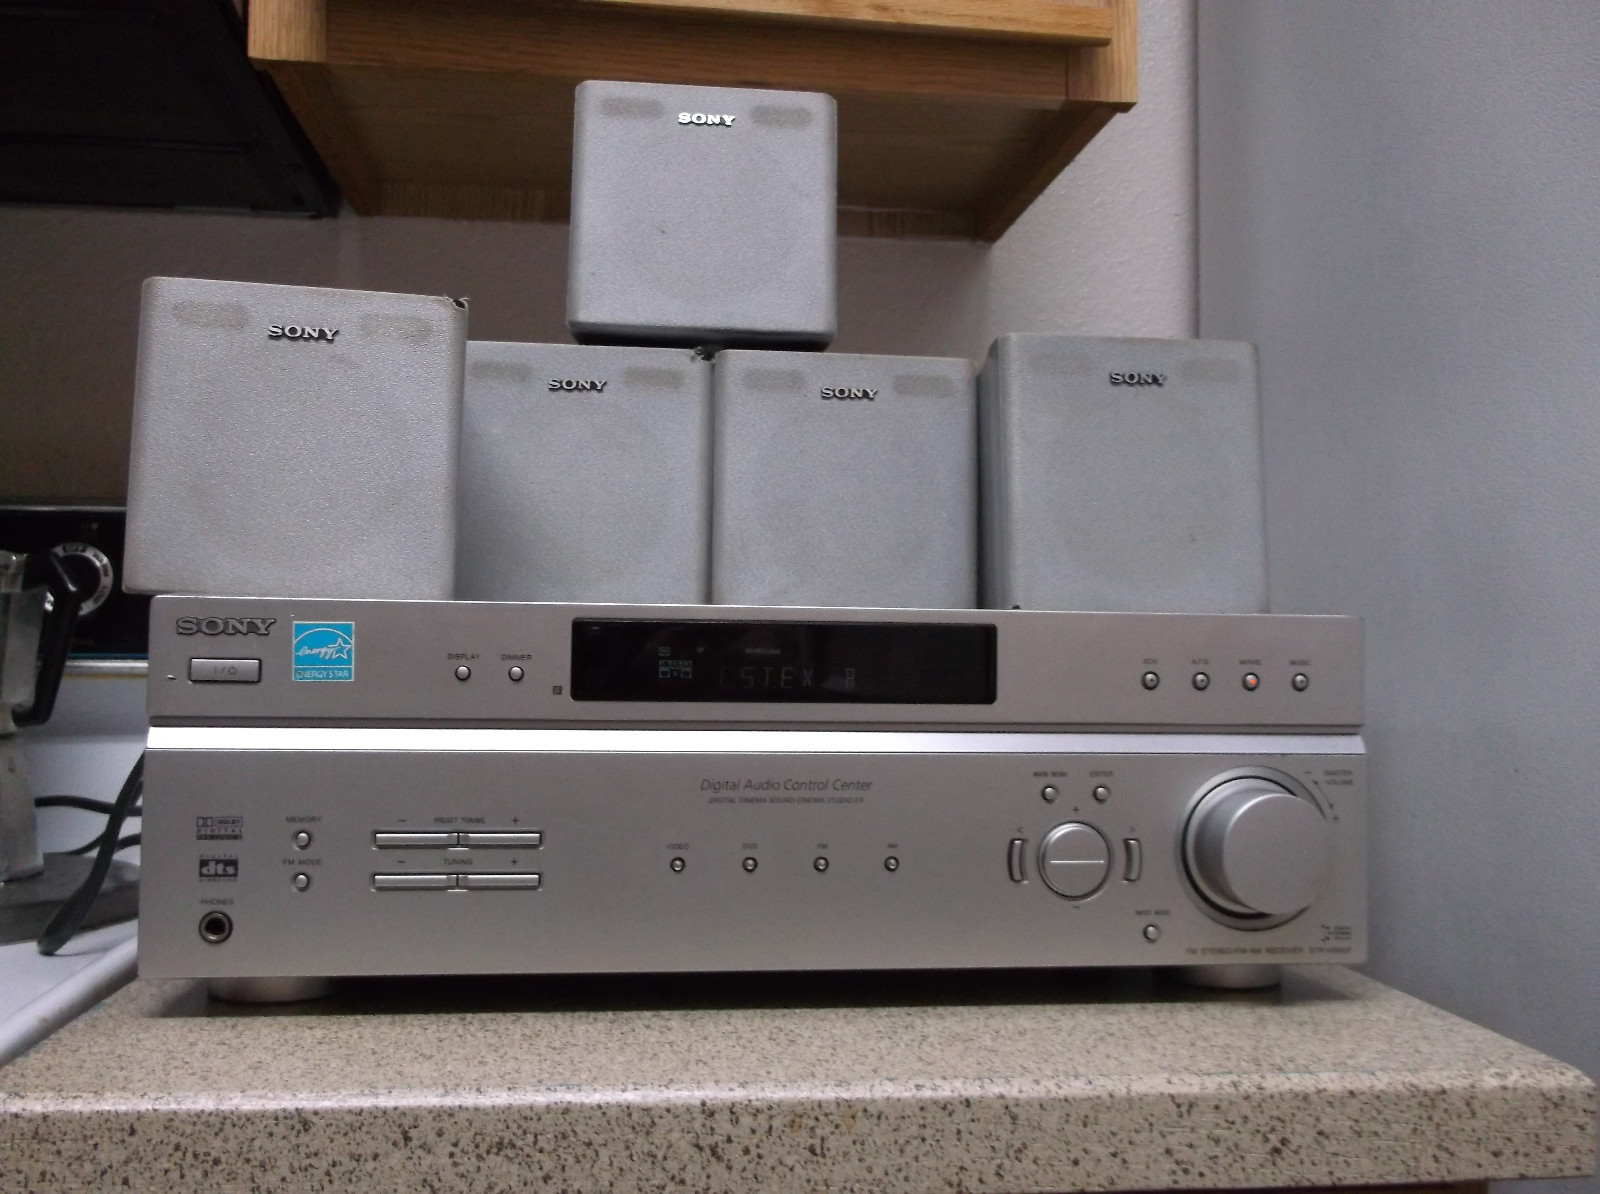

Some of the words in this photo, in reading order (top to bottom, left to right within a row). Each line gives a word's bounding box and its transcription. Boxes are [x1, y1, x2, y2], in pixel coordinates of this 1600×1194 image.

[678, 112, 736, 127] SONY
[267, 324, 339, 343] SONY
[1109, 371, 1166, 387] SONY
[548, 378, 607, 393] SONY
[821, 385, 877, 401] SONY
[175, 616, 277, 637] SONY
[447, 652, 481, 661] DISPLAY
[500, 653, 533, 662] DIMMER
[295, 669, 328, 679] ENERGY
[329, 669, 349, 679] STAR
[699, 778, 740, 794] Digital
[743, 778, 781, 792] Audio
[783, 778, 829, 792] Control
[832, 778, 873, 792] Center
[285, 815, 323, 824] MEMORY
[433, 816, 458, 825] PRESET
[461, 816, 486, 825] TUNING
[666, 842, 690, 850] VIDEO
[282, 858, 296, 866] FM
[297, 858, 323, 866] MODE
[442, 857, 474, 867] TUNING
[200, 859, 238, 876] dts
[199, 898, 235, 906] PHONES
